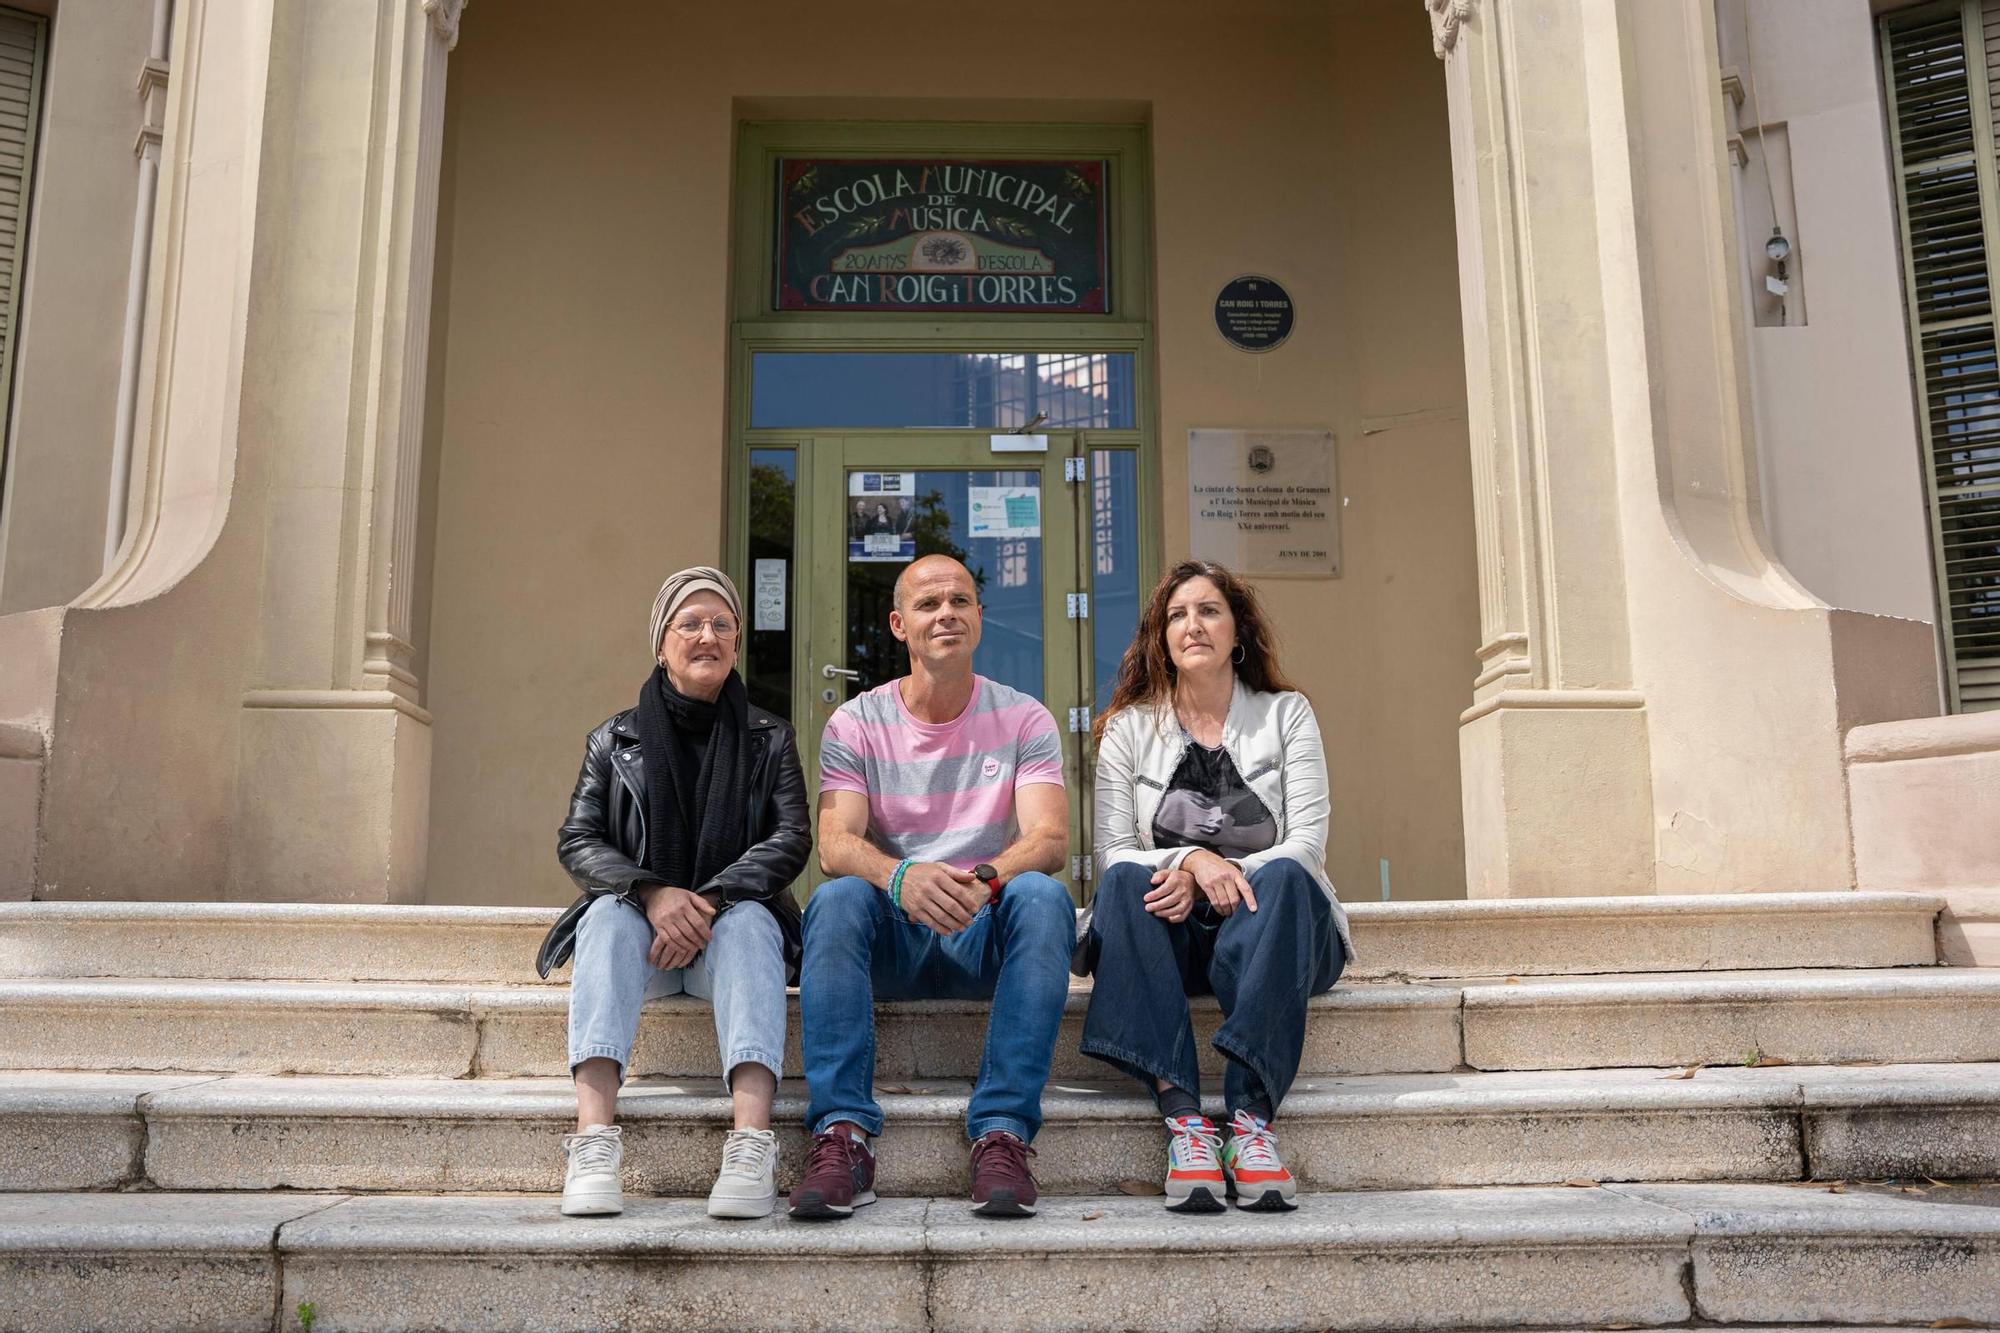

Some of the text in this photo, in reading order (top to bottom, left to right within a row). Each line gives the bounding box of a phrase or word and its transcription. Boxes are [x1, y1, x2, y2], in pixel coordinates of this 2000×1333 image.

[794, 165, 1076, 237] ESCOLA MUNICIPAL
[927, 194, 957, 207] DE
[887, 205, 991, 232] MÚSICA
[977, 254, 1042, 271] D'ESCOLA
[810, 274, 1077, 305] CAN ROIG i TORRES
[1219, 300, 1236, 308] CAN
[1236, 300, 1254, 308] ROIG
[1260, 300, 1289, 309] TORRES
[1194, 485, 1204, 493] La
[1256, 485, 1283, 493] Coloma
[1296, 486, 1331, 494] Gramenet
[1245, 498, 1280, 507] Municipal
[1200, 510, 1215, 518] Can
[1216, 510, 1233, 519] Roig
[1239, 510, 1261, 518] Torres
[1301, 510, 1313, 518] del
[1278, 550, 1327, 558] JUNY DE 2001
